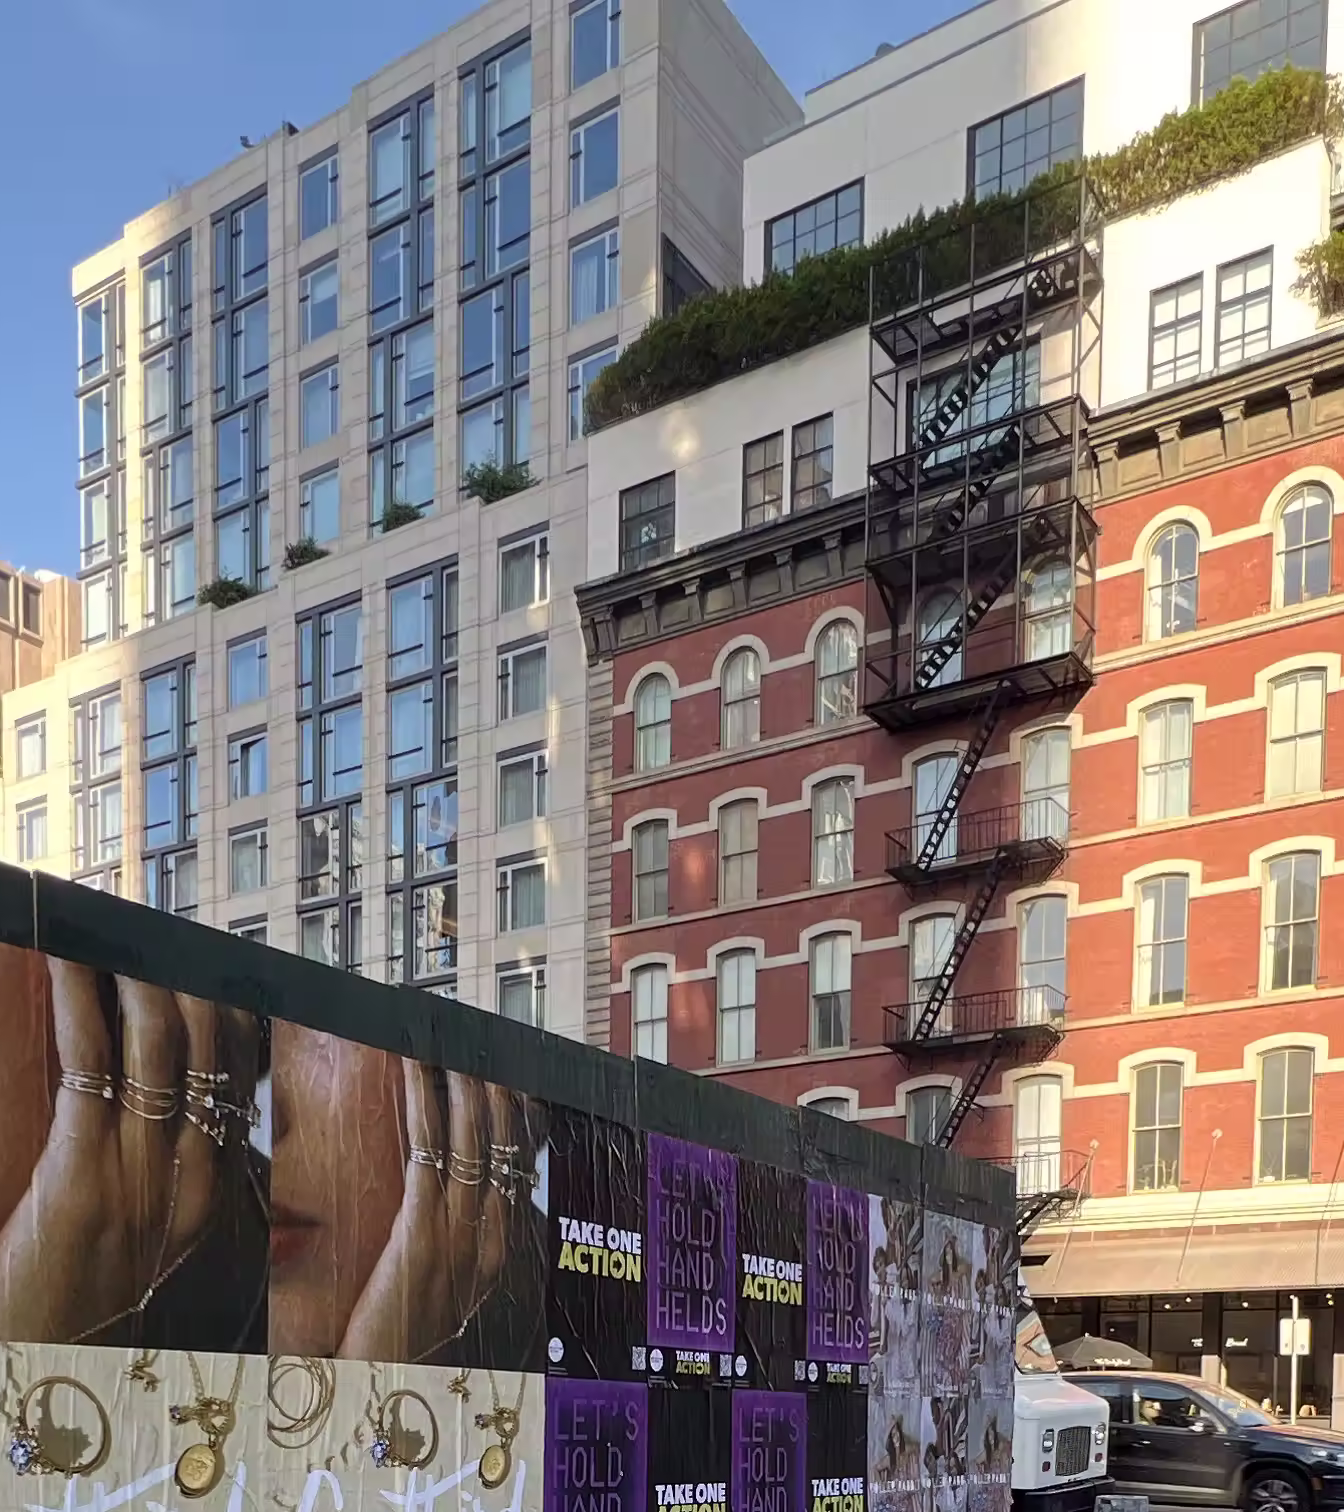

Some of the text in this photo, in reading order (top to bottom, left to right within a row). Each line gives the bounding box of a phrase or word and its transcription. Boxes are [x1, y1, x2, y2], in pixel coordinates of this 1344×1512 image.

[558, 1216, 641, 1255] TAKE ONE
[657, 1200, 715, 1247] HOLD
[558, 1242, 641, 1282] ACTION
[657, 1244, 714, 1290] HAND
[742, 1253, 802, 1282] TAKE ONE
[742, 1274, 802, 1305] ACTION
[813, 1275, 855, 1311] HAND
[656, 1289, 727, 1335] HELDS
[813, 1313, 864, 1349] HELDS
[676, 1350, 693, 1361] TAKE
[676, 1362, 710, 1375] ACTION
[555, 1399, 639, 1441] LET'S
[738, 1408, 799, 1442] LET'S
[553, 1447, 623, 1488] HOLD
[737, 1447, 787, 1483] HOLD
[655, 1483, 726, 1505] TAKE ONE
[811, 1479, 839, 1497] TAKE
[841, 1477, 863, 1495] ONE
